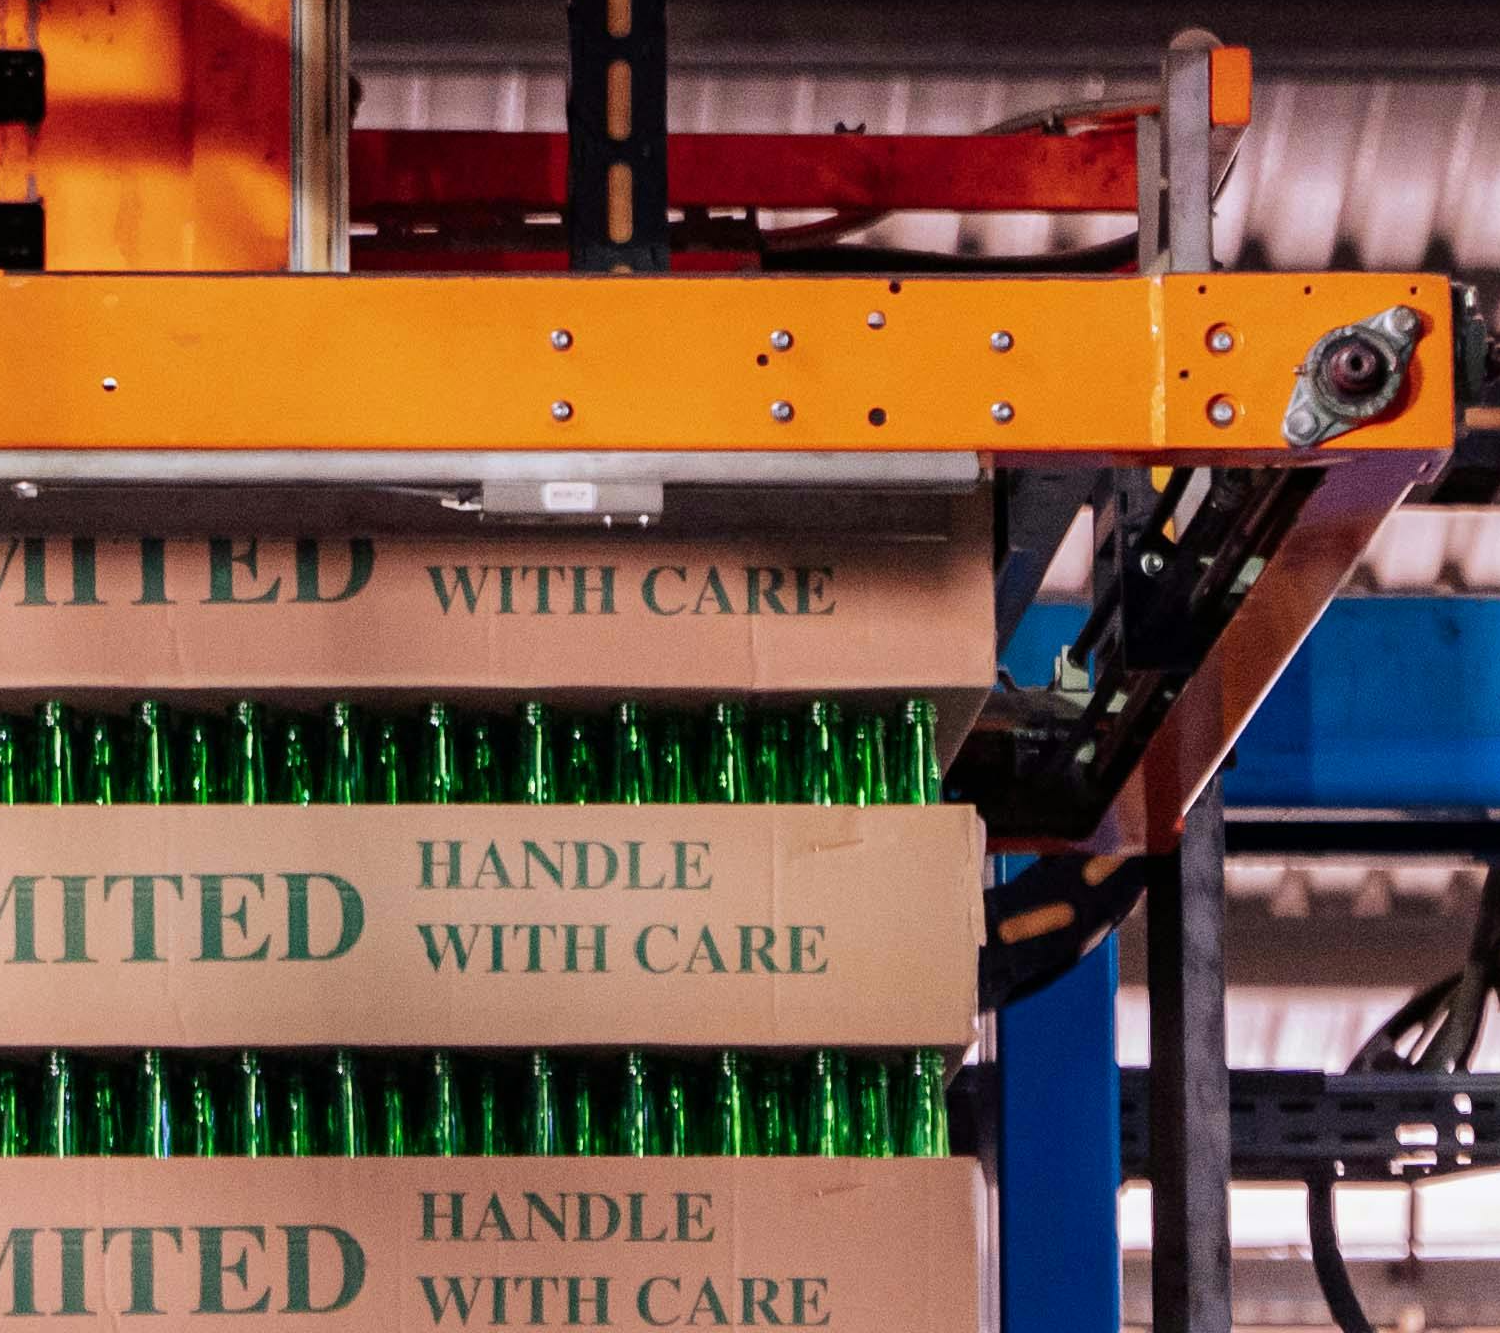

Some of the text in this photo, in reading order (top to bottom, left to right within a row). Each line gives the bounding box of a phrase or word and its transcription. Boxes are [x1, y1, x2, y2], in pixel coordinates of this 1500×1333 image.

[426, 564, 836, 616] WITH CARE
[416, 839, 714, 891] HANDLE
[415, 922, 830, 975] WITH CARE
[417, 1191, 716, 1242] HANDLE
[416, 1275, 832, 1327] WITH CARE
